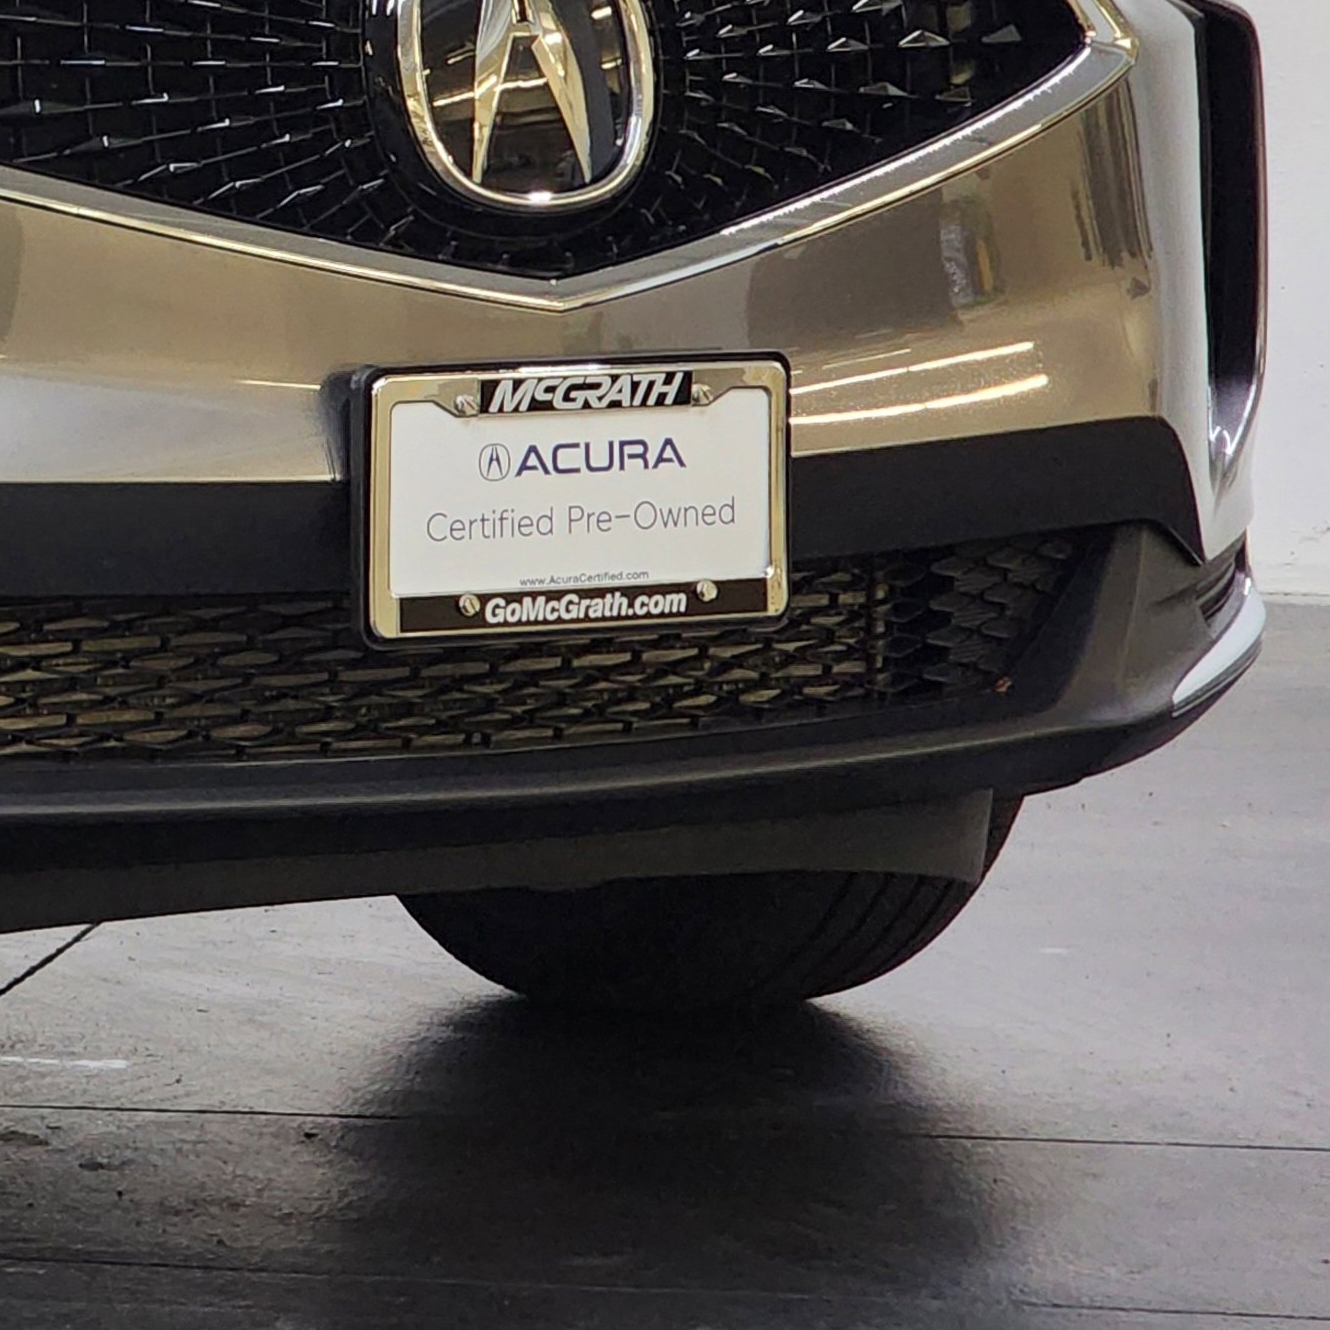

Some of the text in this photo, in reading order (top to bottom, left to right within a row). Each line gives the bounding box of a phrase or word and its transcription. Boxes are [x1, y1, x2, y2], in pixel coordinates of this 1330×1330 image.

[514, 437, 687, 478] ACURA
[426, 496, 736, 542] Certified Pre-Owned
[519, 569, 650, 586] www.AcuraCertified.com
[485, 590, 687, 625] GoMcGrath.com
